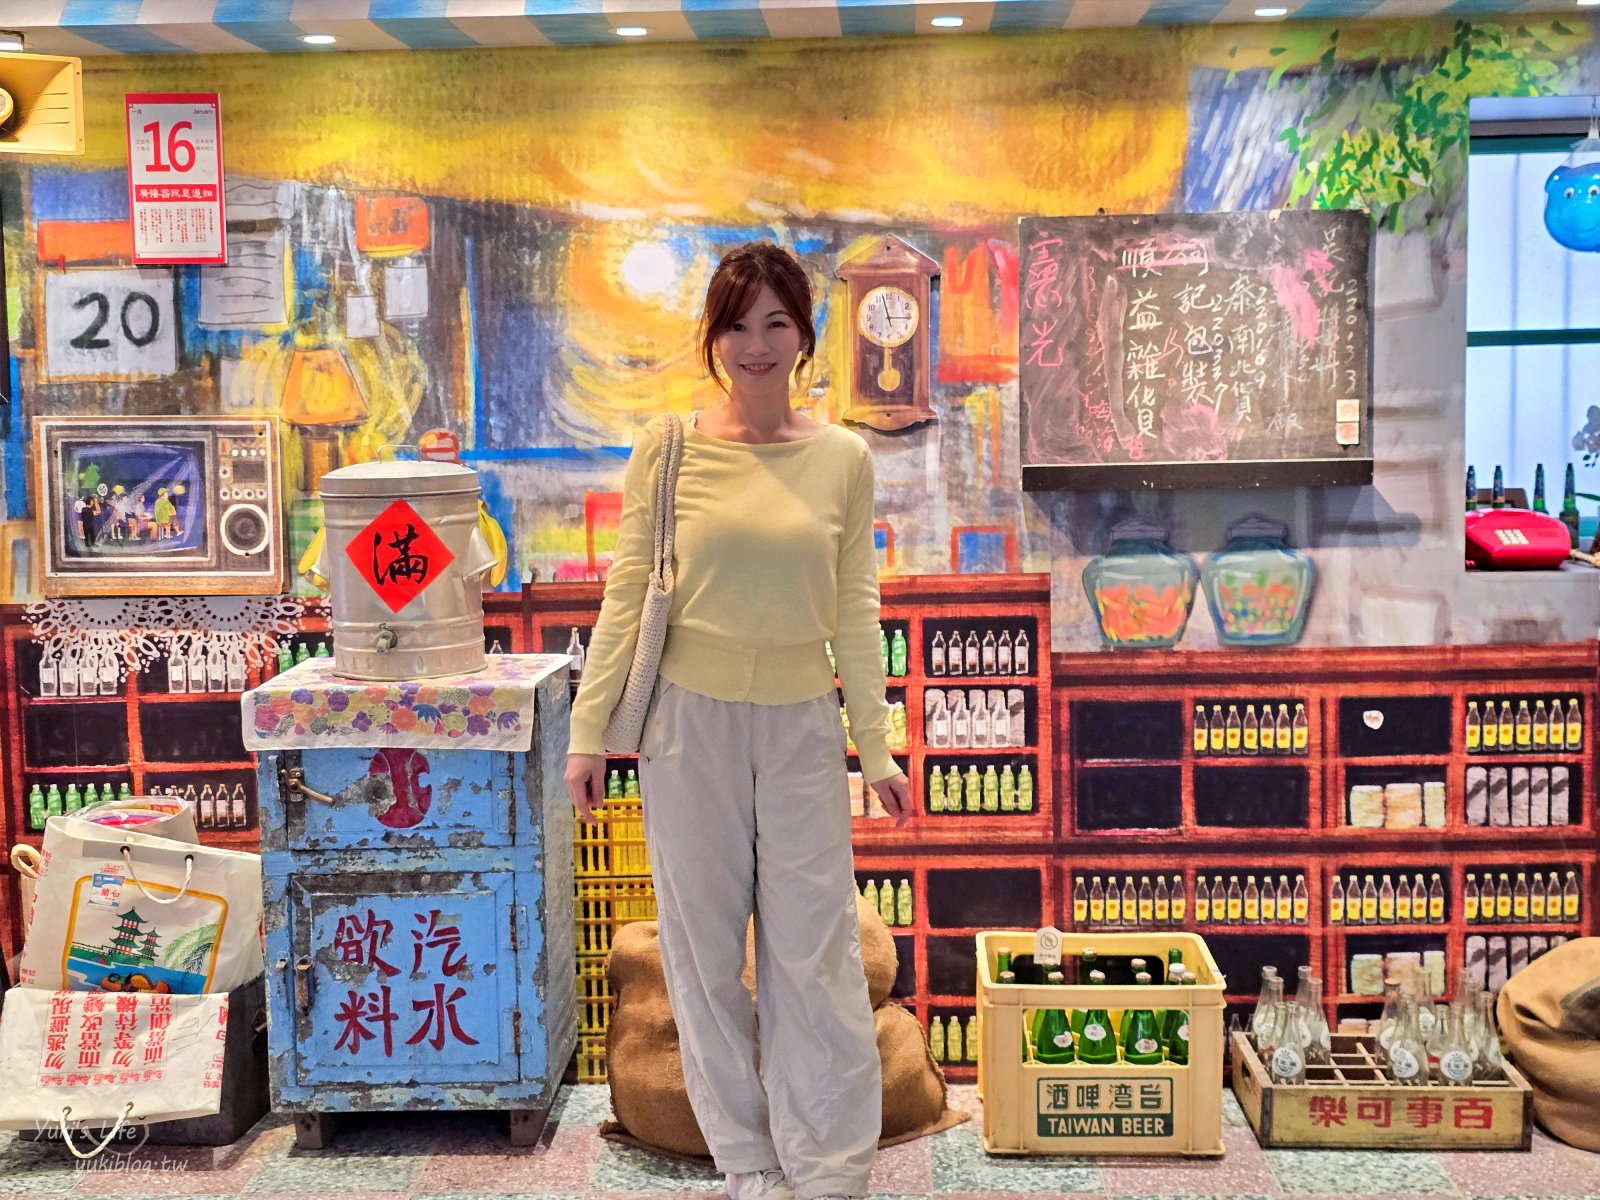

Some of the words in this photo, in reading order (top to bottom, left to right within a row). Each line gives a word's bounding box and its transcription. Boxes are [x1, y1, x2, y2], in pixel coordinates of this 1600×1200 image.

[143, 120, 197, 173] 16
[70, 290, 161, 351] 20
[373, 523, 430, 588] 滿
[76, 991, 107, 1069] 而當改變
[112, 992, 140, 1069] 勿等待機
[1047, 1117, 1115, 1136] TAIWAN
[1121, 1117, 1166, 1136] BEER
